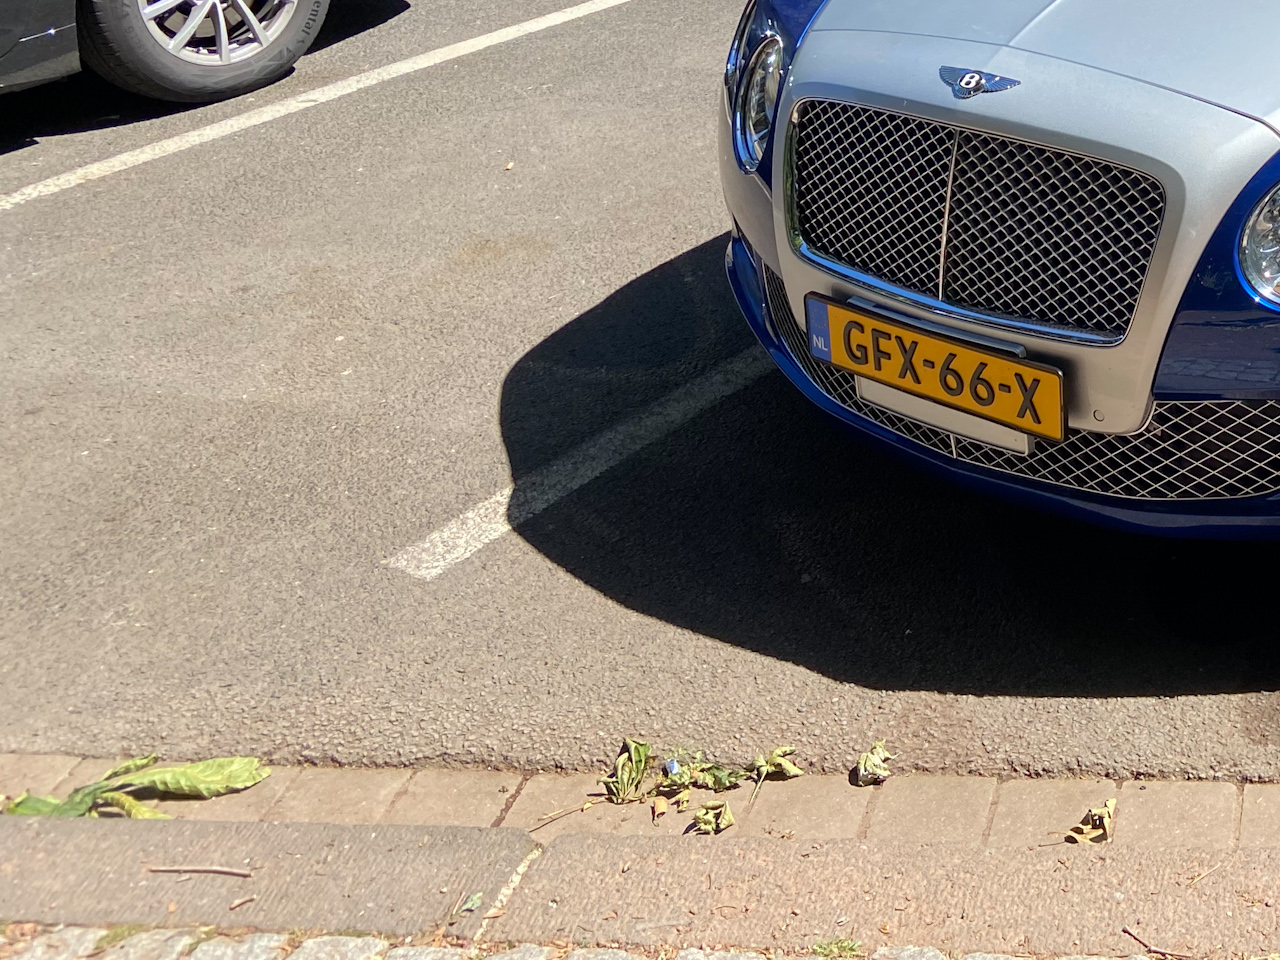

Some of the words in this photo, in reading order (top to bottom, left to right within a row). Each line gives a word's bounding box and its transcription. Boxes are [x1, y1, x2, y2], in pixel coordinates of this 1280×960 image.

[959, 72, 980, 89] B
[813, 335, 829, 352] NL
[843, 320, 1042, 425] GFX-66-X
